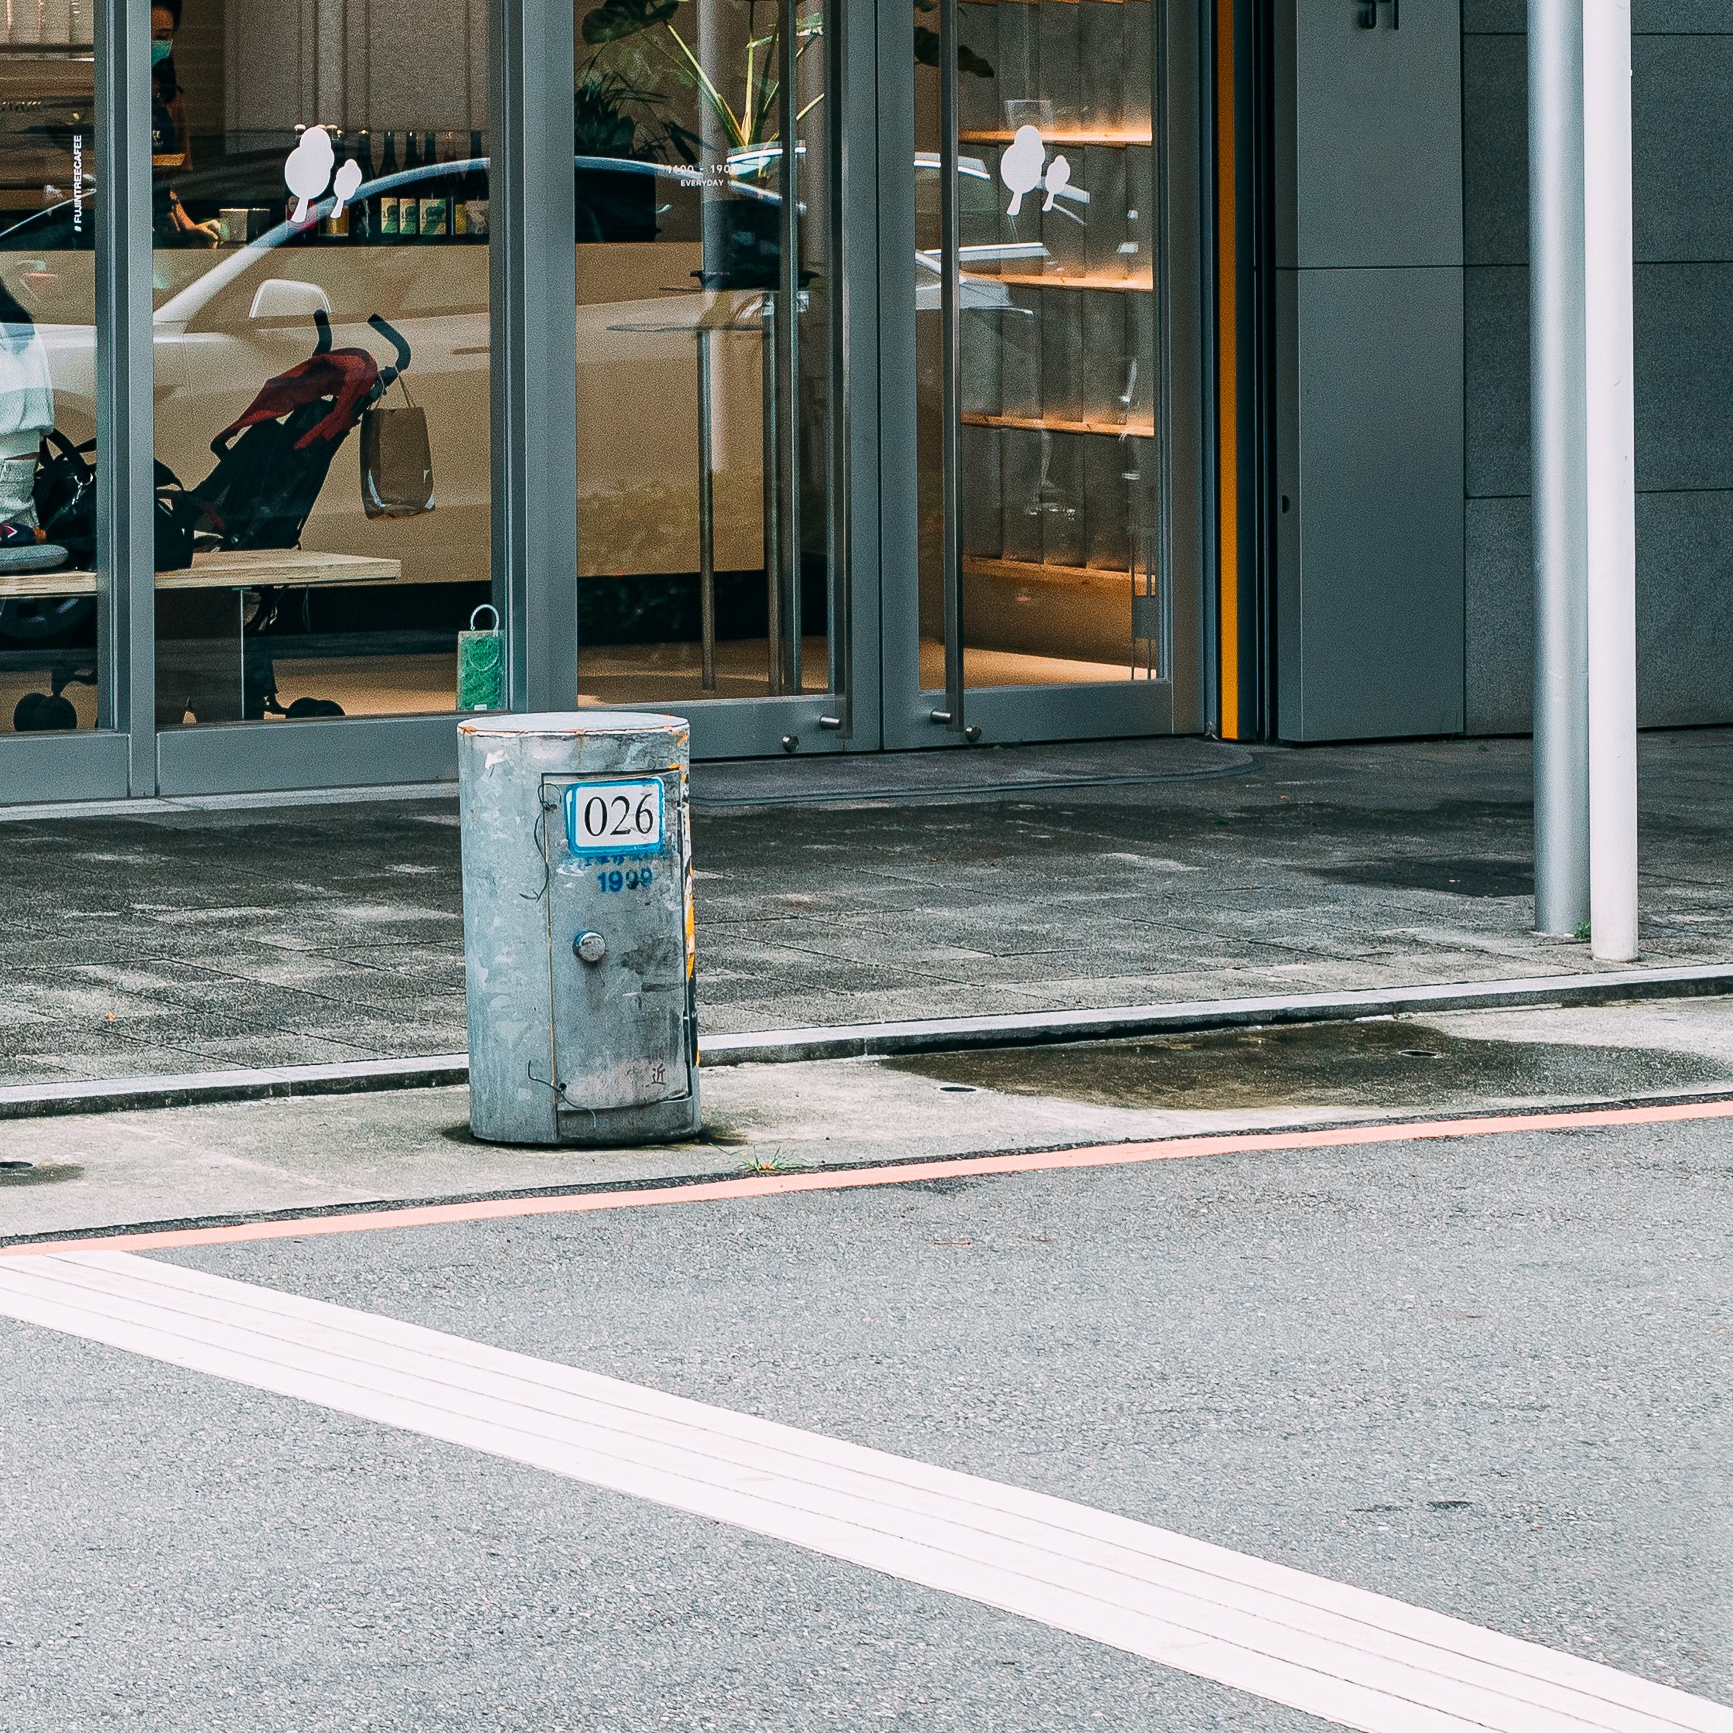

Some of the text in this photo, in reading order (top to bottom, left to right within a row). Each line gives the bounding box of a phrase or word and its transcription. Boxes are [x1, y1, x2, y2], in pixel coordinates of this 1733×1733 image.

[73, 134, 82, 224] FUJINTREECAFEE
[709, 164, 736, 174] 190
[680, 179, 724, 187] EVERYDAY
[584, 793, 654, 837] 026
[597, 867, 653, 893] 1999
